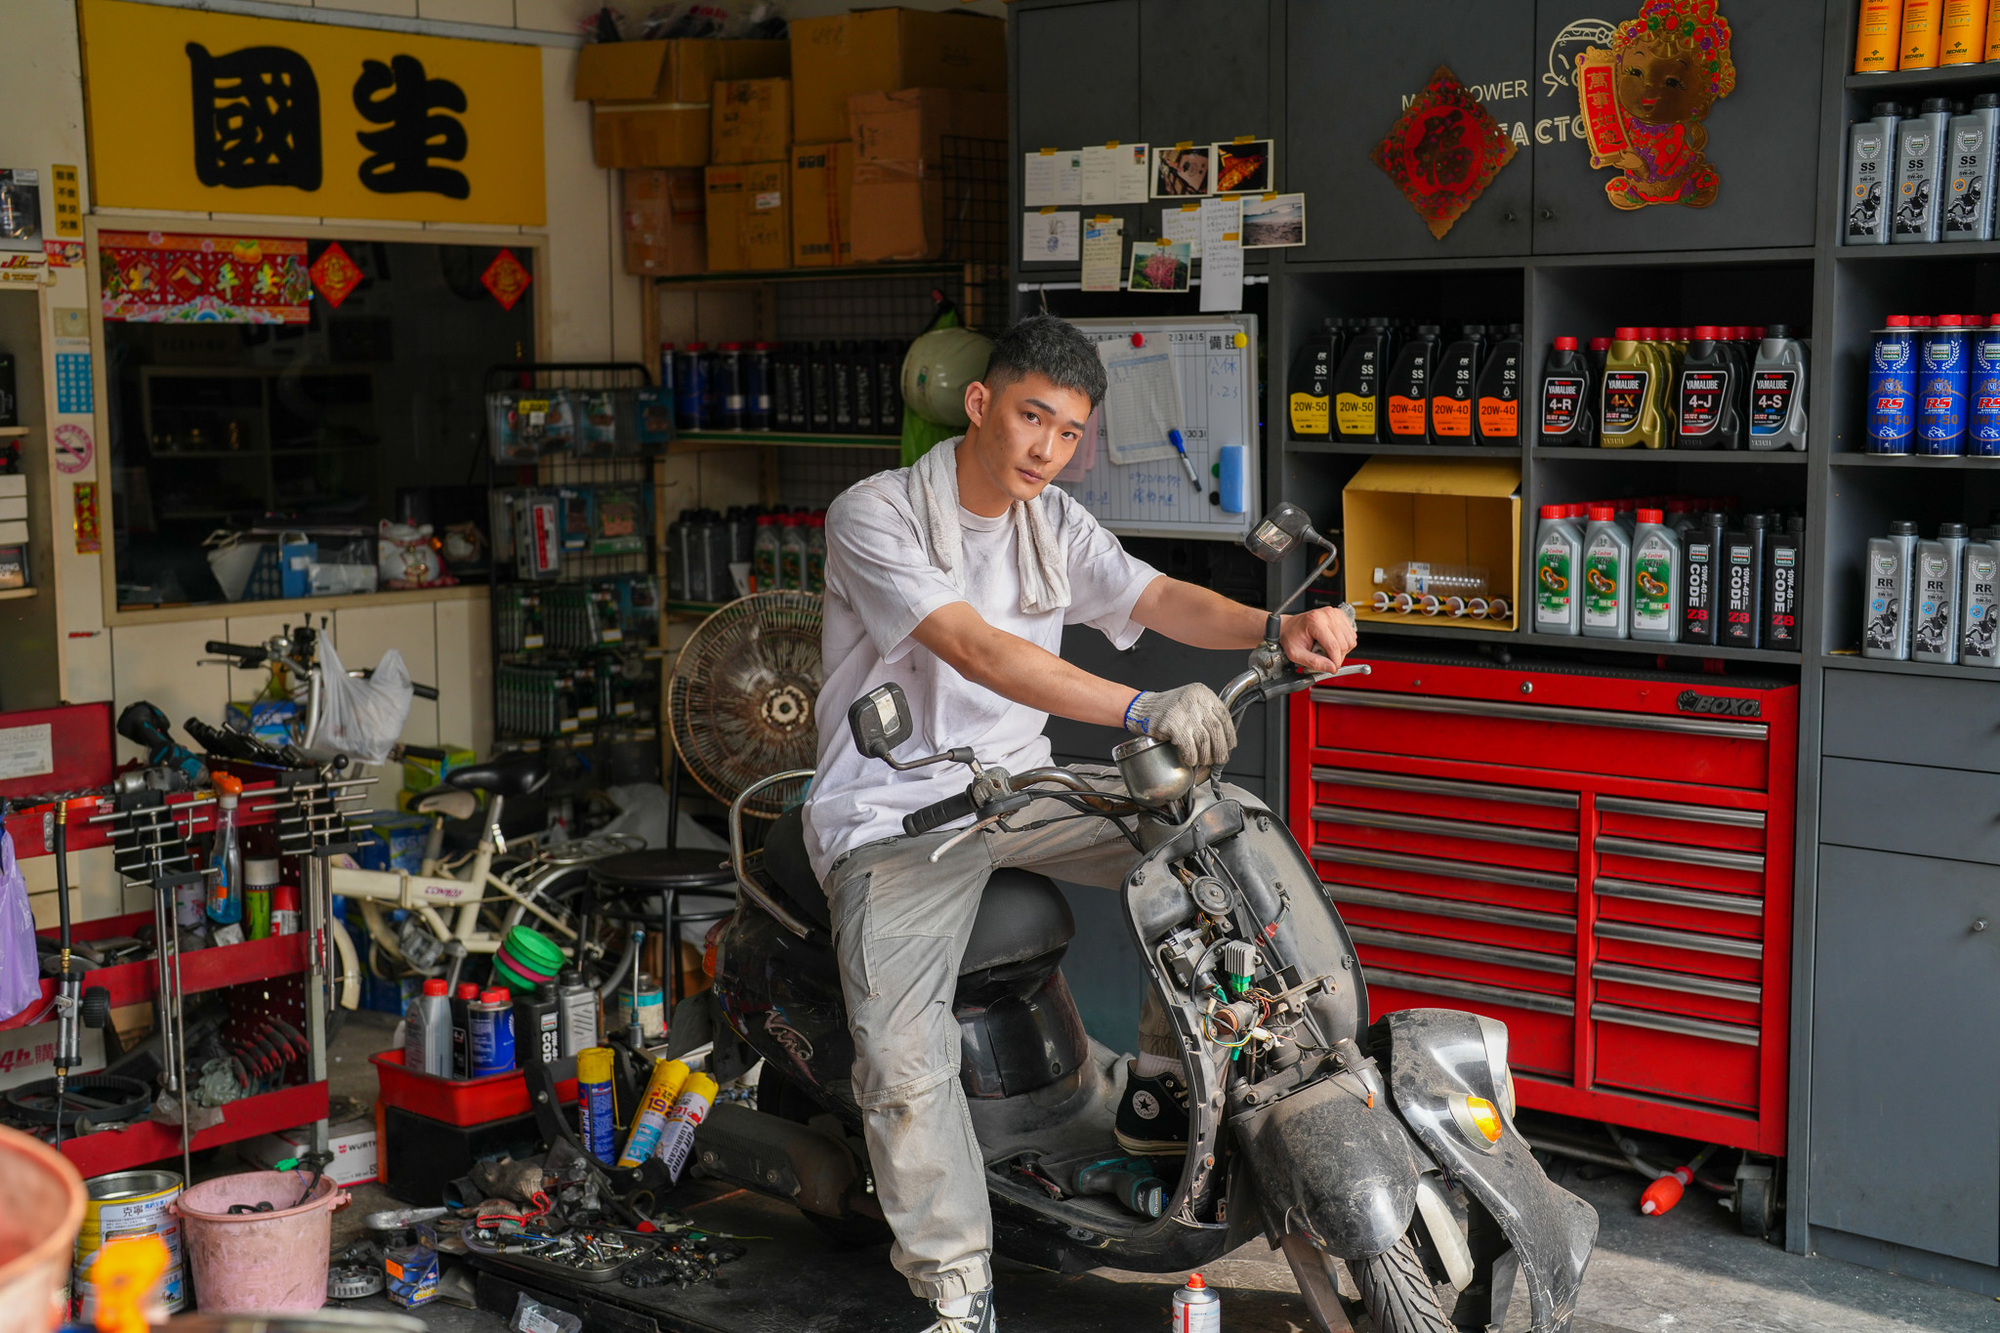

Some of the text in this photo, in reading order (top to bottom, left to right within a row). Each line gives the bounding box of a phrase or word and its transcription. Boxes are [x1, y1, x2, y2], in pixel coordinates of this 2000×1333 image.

[186, 42, 470, 199] 國生
[1908, 159, 1924, 169] SS
[1960, 155, 1976, 165] SS
[1860, 162, 1876, 171] SS
[1315, 365, 1327, 374] SS
[1361, 365, 1374, 374] SS
[1412, 369, 1424, 379] SS
[1457, 370, 1469, 379] SS
[1503, 370, 1516, 379] SS
[1608, 380, 1639, 389] YAMALUBE
[1686, 380, 1718, 389] YAMALUBE
[1756, 380, 1787, 389] YAMALUBE
[1548, 386, 1576, 395] YAMALUBE
[1550, 398, 1572, 410] 4-R
[1611, 394, 1635, 408] 4-X
[1689, 394, 1712, 408] 4-J
[1758, 394, 1782, 408] 4-S
[1876, 397, 1904, 409] RS
[1924, 397, 1952, 409] RS
[1294, 402, 1327, 412] 20W-50
[1340, 402, 1373, 412] 20W-50
[1391, 404, 1423, 414] 20W-40
[1435, 405, 1468, 415] 20W-40
[1482, 405, 1515, 415] 20W-40
[1871, 415, 1909, 425] 5W-50
[1919, 415, 1958, 425] 5W-50
[1972, 415, 2000, 425] 5W-5
[1700, 564, 1708, 593] 10W-40
[1742, 567, 1750, 596] 10W-40
[1877, 578, 1893, 587] RR
[1688, 563, 1701, 607] CODE
[1730, 566, 1742, 610] CODE
[1786, 569, 1794, 599] 10W-40
[1927, 581, 1943, 590] RR
[1975, 584, 1992, 593] RR
[1774, 568, 1786, 613] CODE
[1686, 609, 1708, 621] Z8
[1728, 611, 1750, 623] Z8
[1772, 614, 1794, 626] Z8
[1694, 695, 1759, 717] BOXO
[542, 1031, 552, 1063] COD
